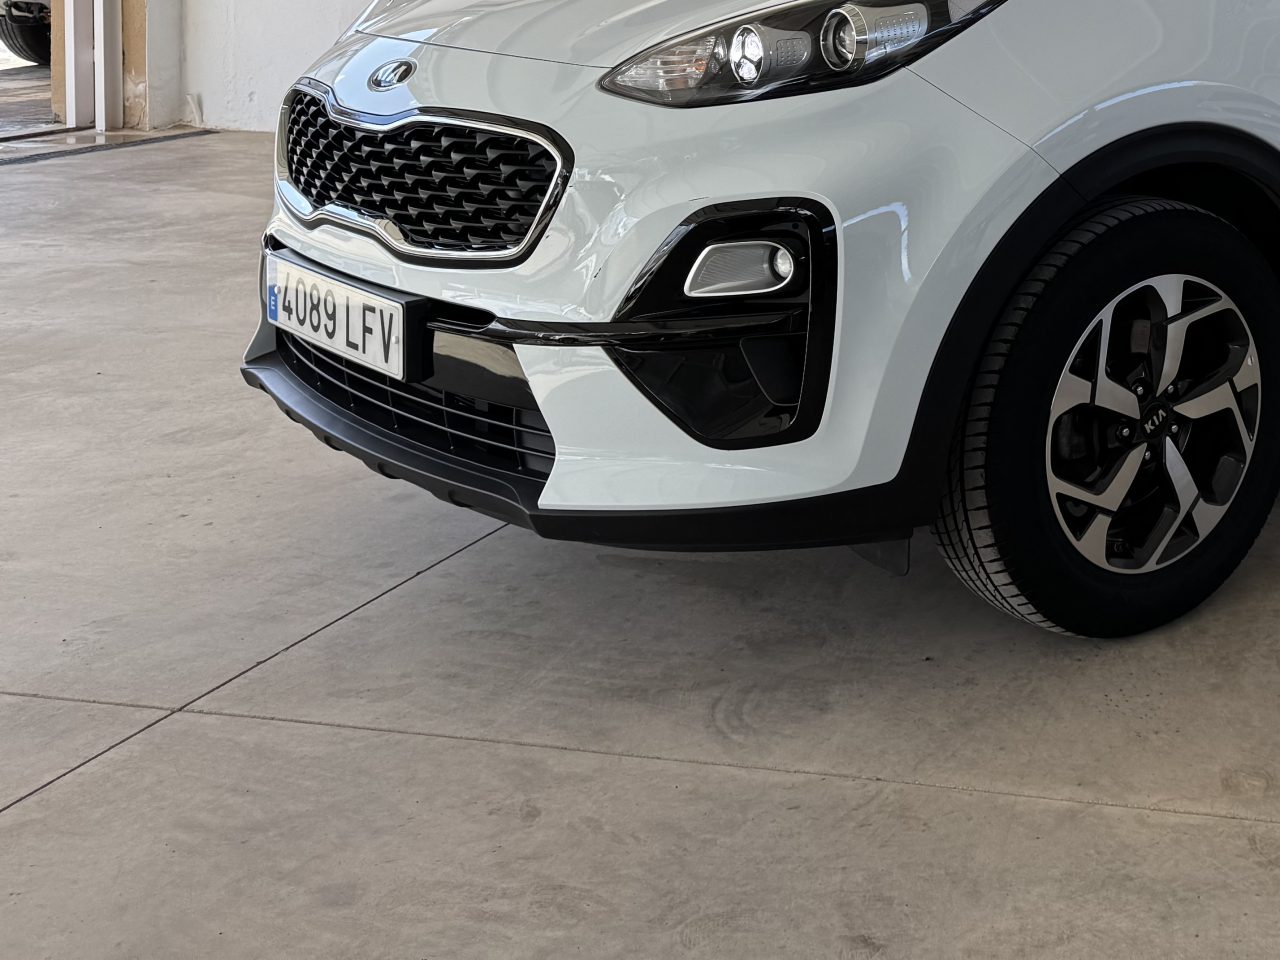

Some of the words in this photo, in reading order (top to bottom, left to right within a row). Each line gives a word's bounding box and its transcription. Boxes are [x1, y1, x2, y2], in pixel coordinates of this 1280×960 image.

[282, 272, 337, 340] 4089
[345, 295, 394, 364] LFV
[1144, 409, 1167, 434] KIA
